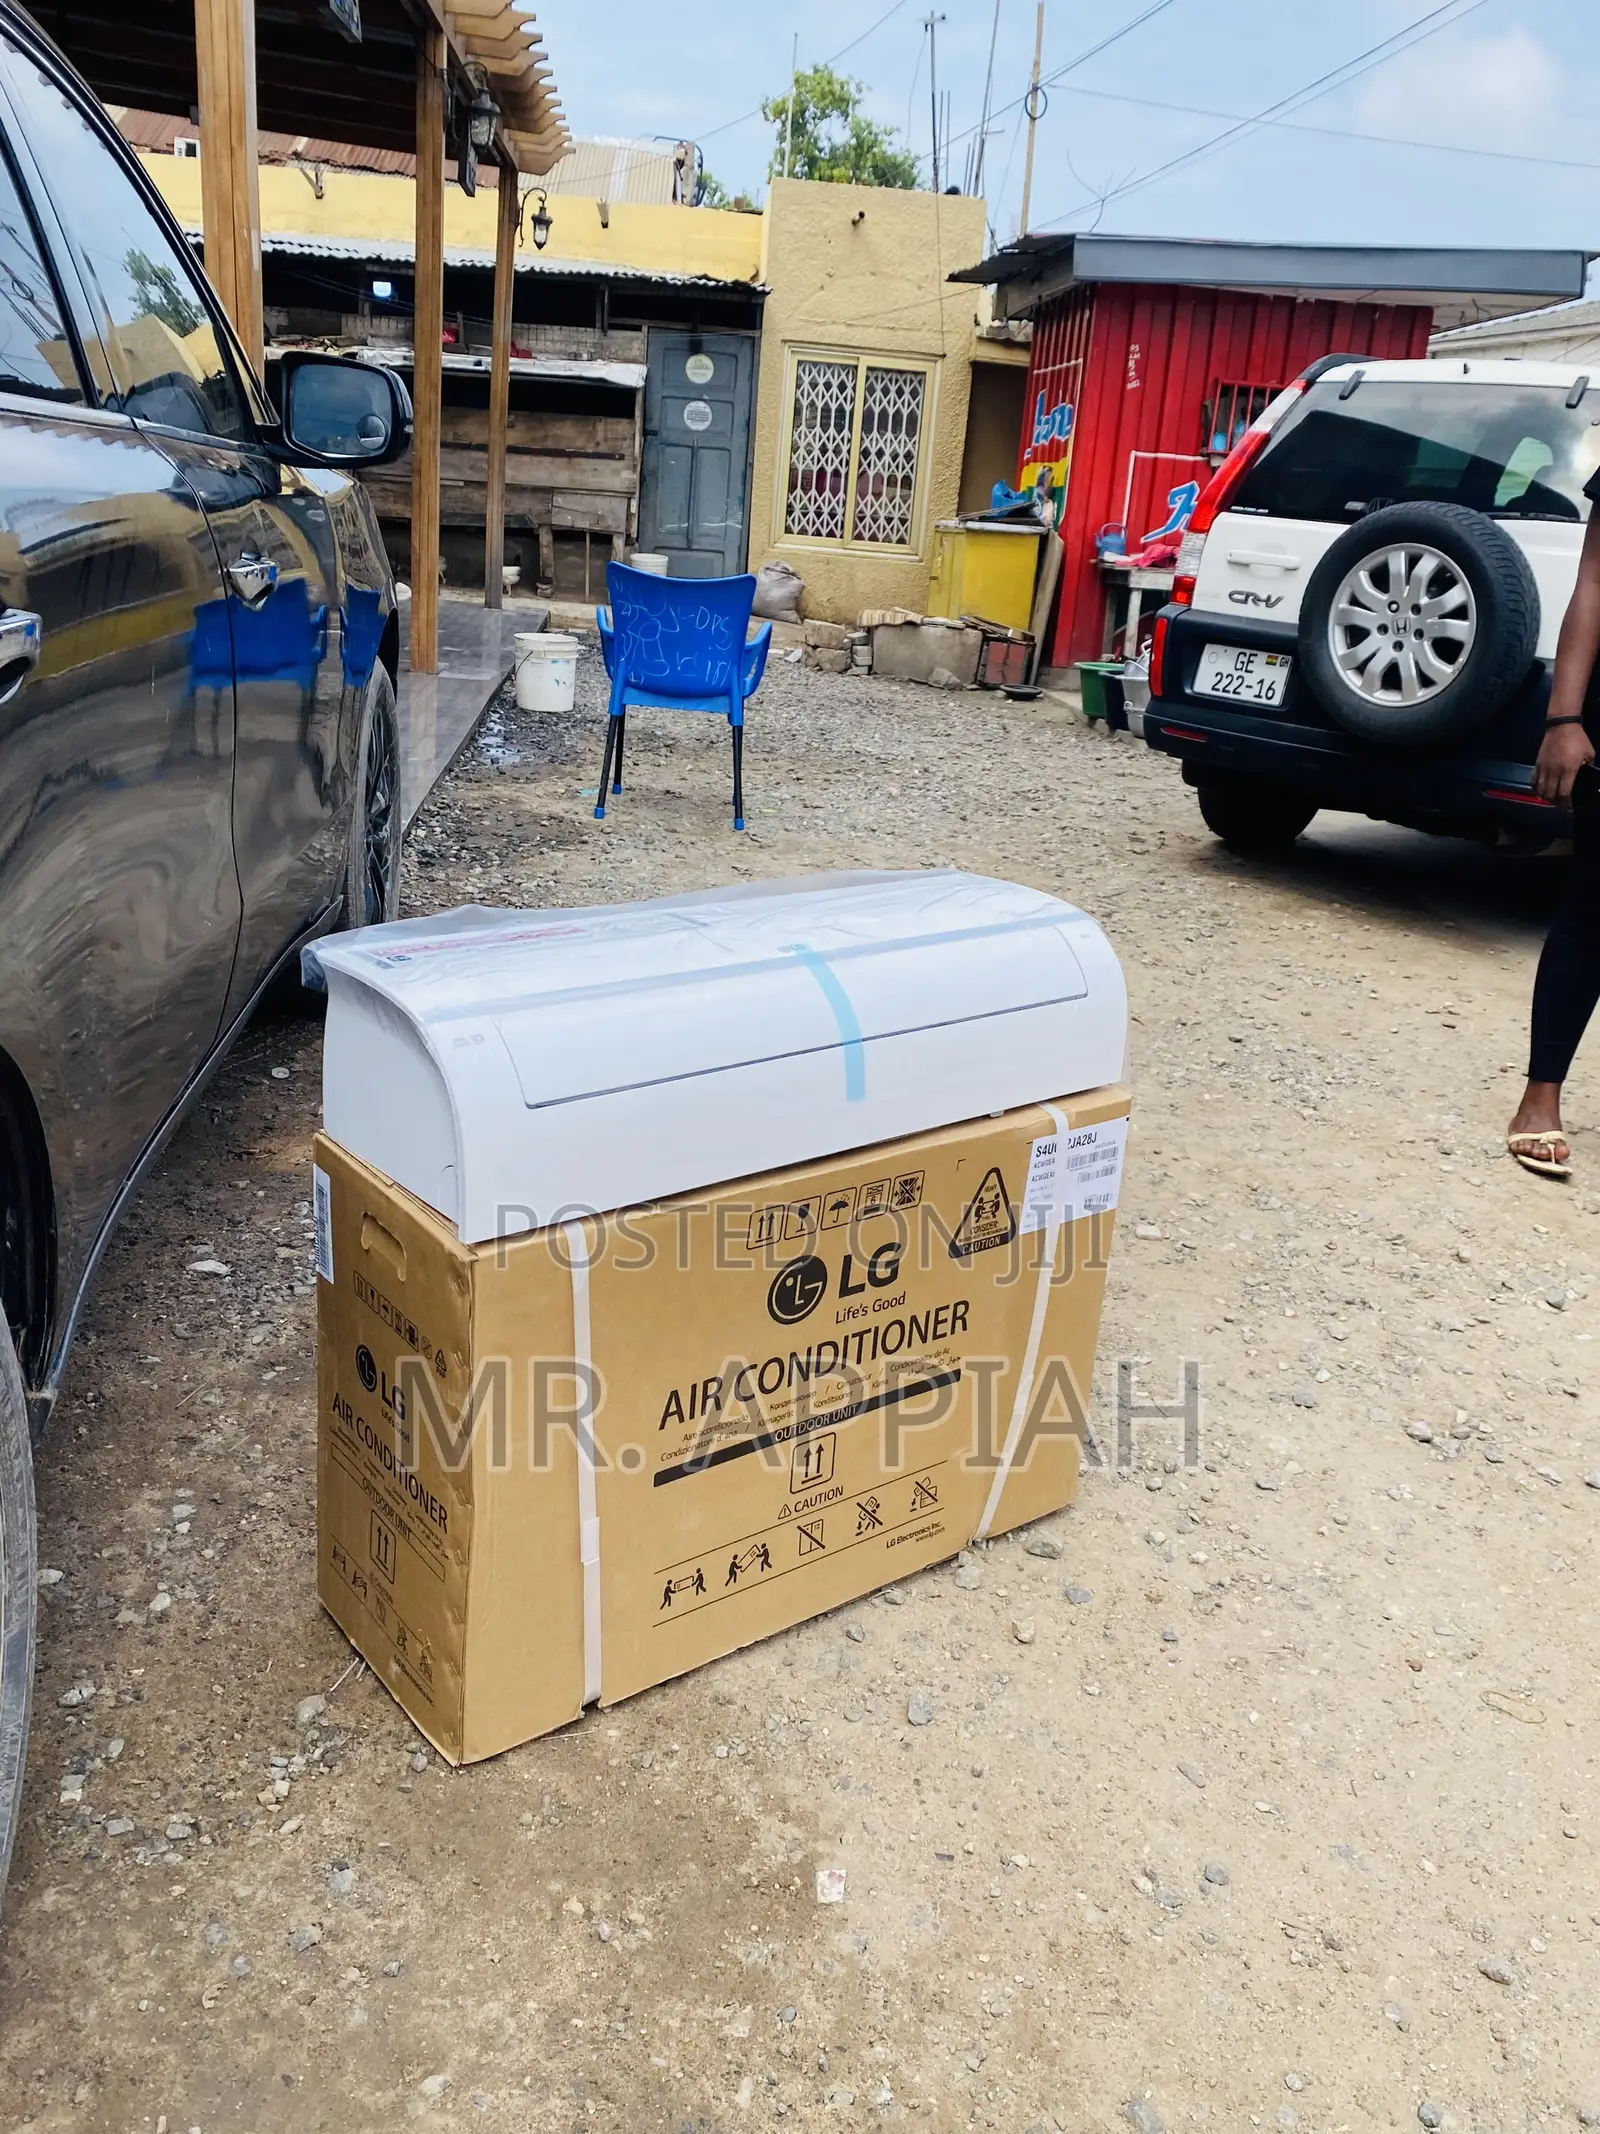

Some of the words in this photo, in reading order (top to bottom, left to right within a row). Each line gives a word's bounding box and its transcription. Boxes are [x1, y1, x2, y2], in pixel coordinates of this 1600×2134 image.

[1234, 652, 1258, 673] GE
[1279, 656, 1290, 667] GH
[1211, 671, 1276, 701] 222-16
[962, 1236, 1000, 1254] CAUTION
[838, 1242, 902, 1299] LG
[835, 1303, 868, 1324] Life's
[872, 1291, 906, 1312] Good
[658, 1376, 723, 1431] AIR
[734, 1300, 969, 1402] CONDITIONER
[381, 1371, 405, 1421] LG
[775, 1413, 830, 1441] OUTDOOR
[832, 1403, 858, 1422] UNIT
[332, 1392, 354, 1431] AIR
[356, 1416, 448, 1535] CONDITIONER
[793, 1485, 844, 1513] CAUTION
[886, 1538, 896, 1549] LG
[896, 1525, 931, 1545] Electronics
